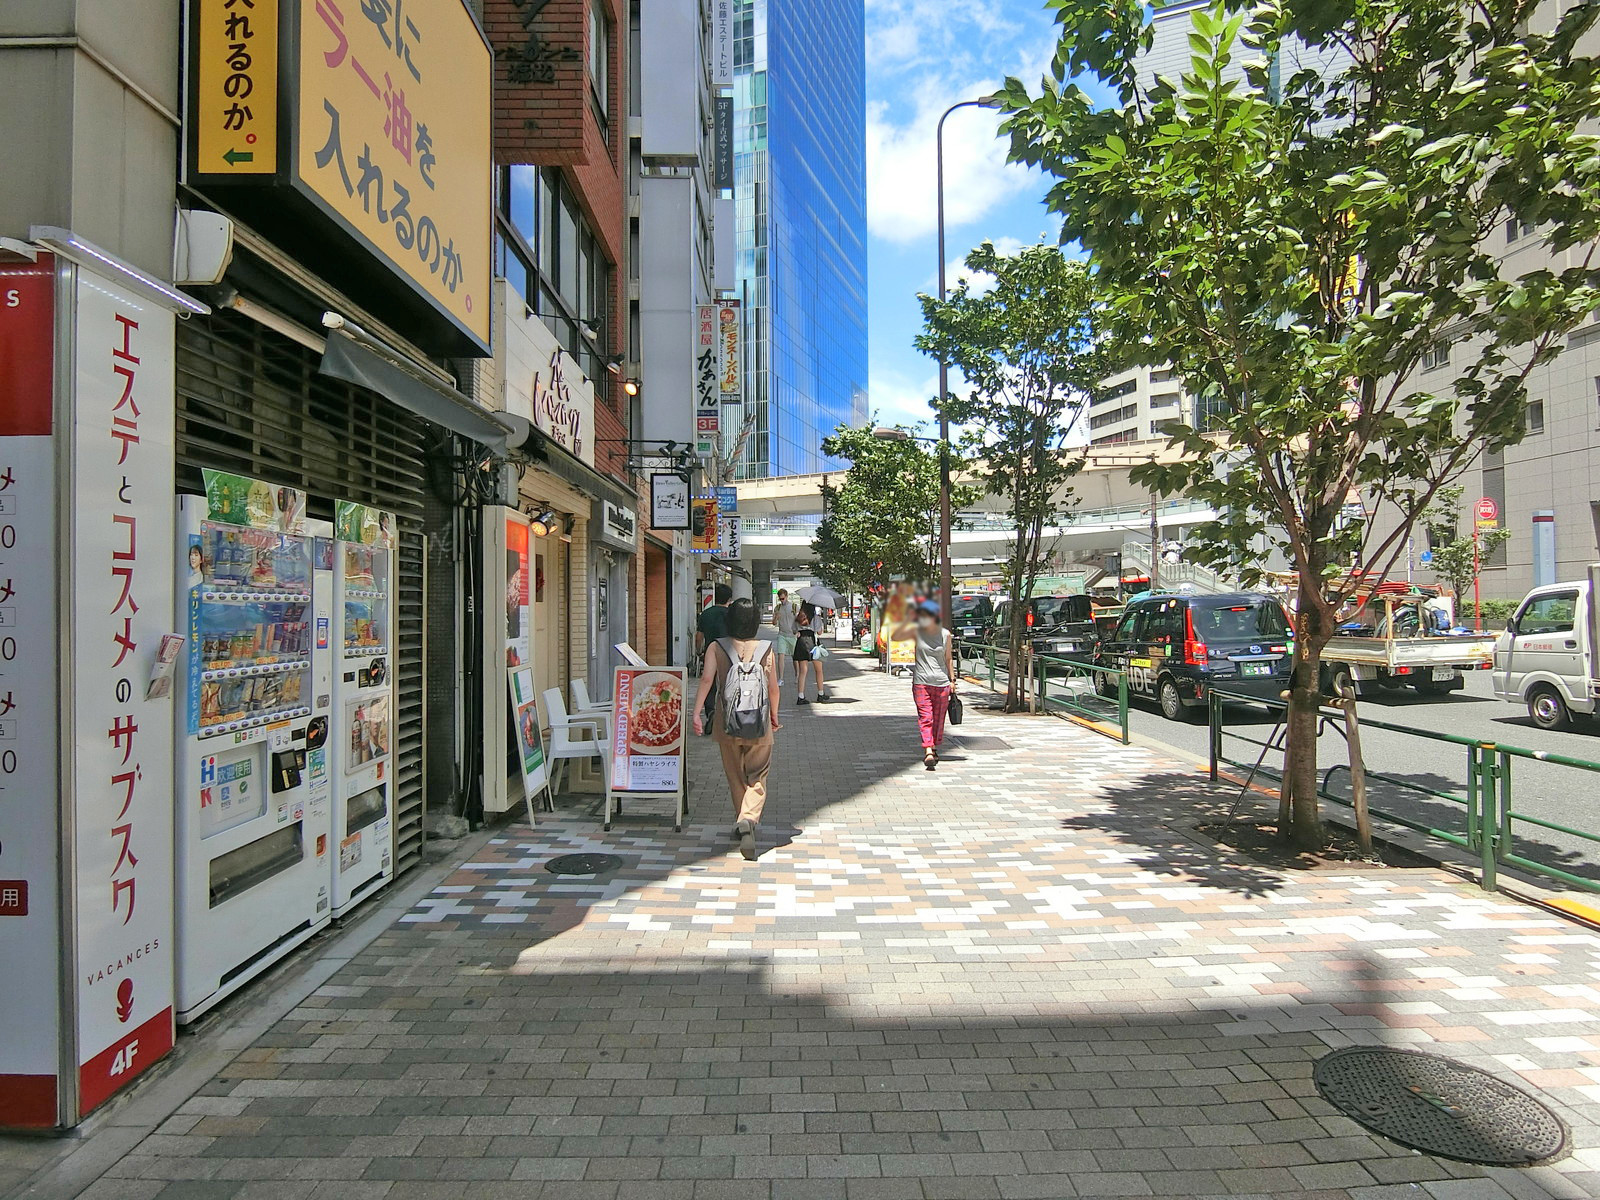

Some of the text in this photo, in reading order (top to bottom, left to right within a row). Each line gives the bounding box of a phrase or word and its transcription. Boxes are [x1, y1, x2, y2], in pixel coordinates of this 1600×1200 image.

[223, 0, 257, 145] れるのか。
[718, 102, 729, 181] 5F タイ古式マッサージ
[314, 97, 473, 314] 入れるのか。
[700, 308, 713, 345] 居酒屋
[698, 420, 718, 430] 3F
[108, 311, 142, 927] エステとコスメのサブスク
[619, 672, 631, 712] MENU
[616, 714, 629, 755] SPEED
[87, 938, 160, 986] VACANCES
[110, 1039, 139, 1078] 4F
